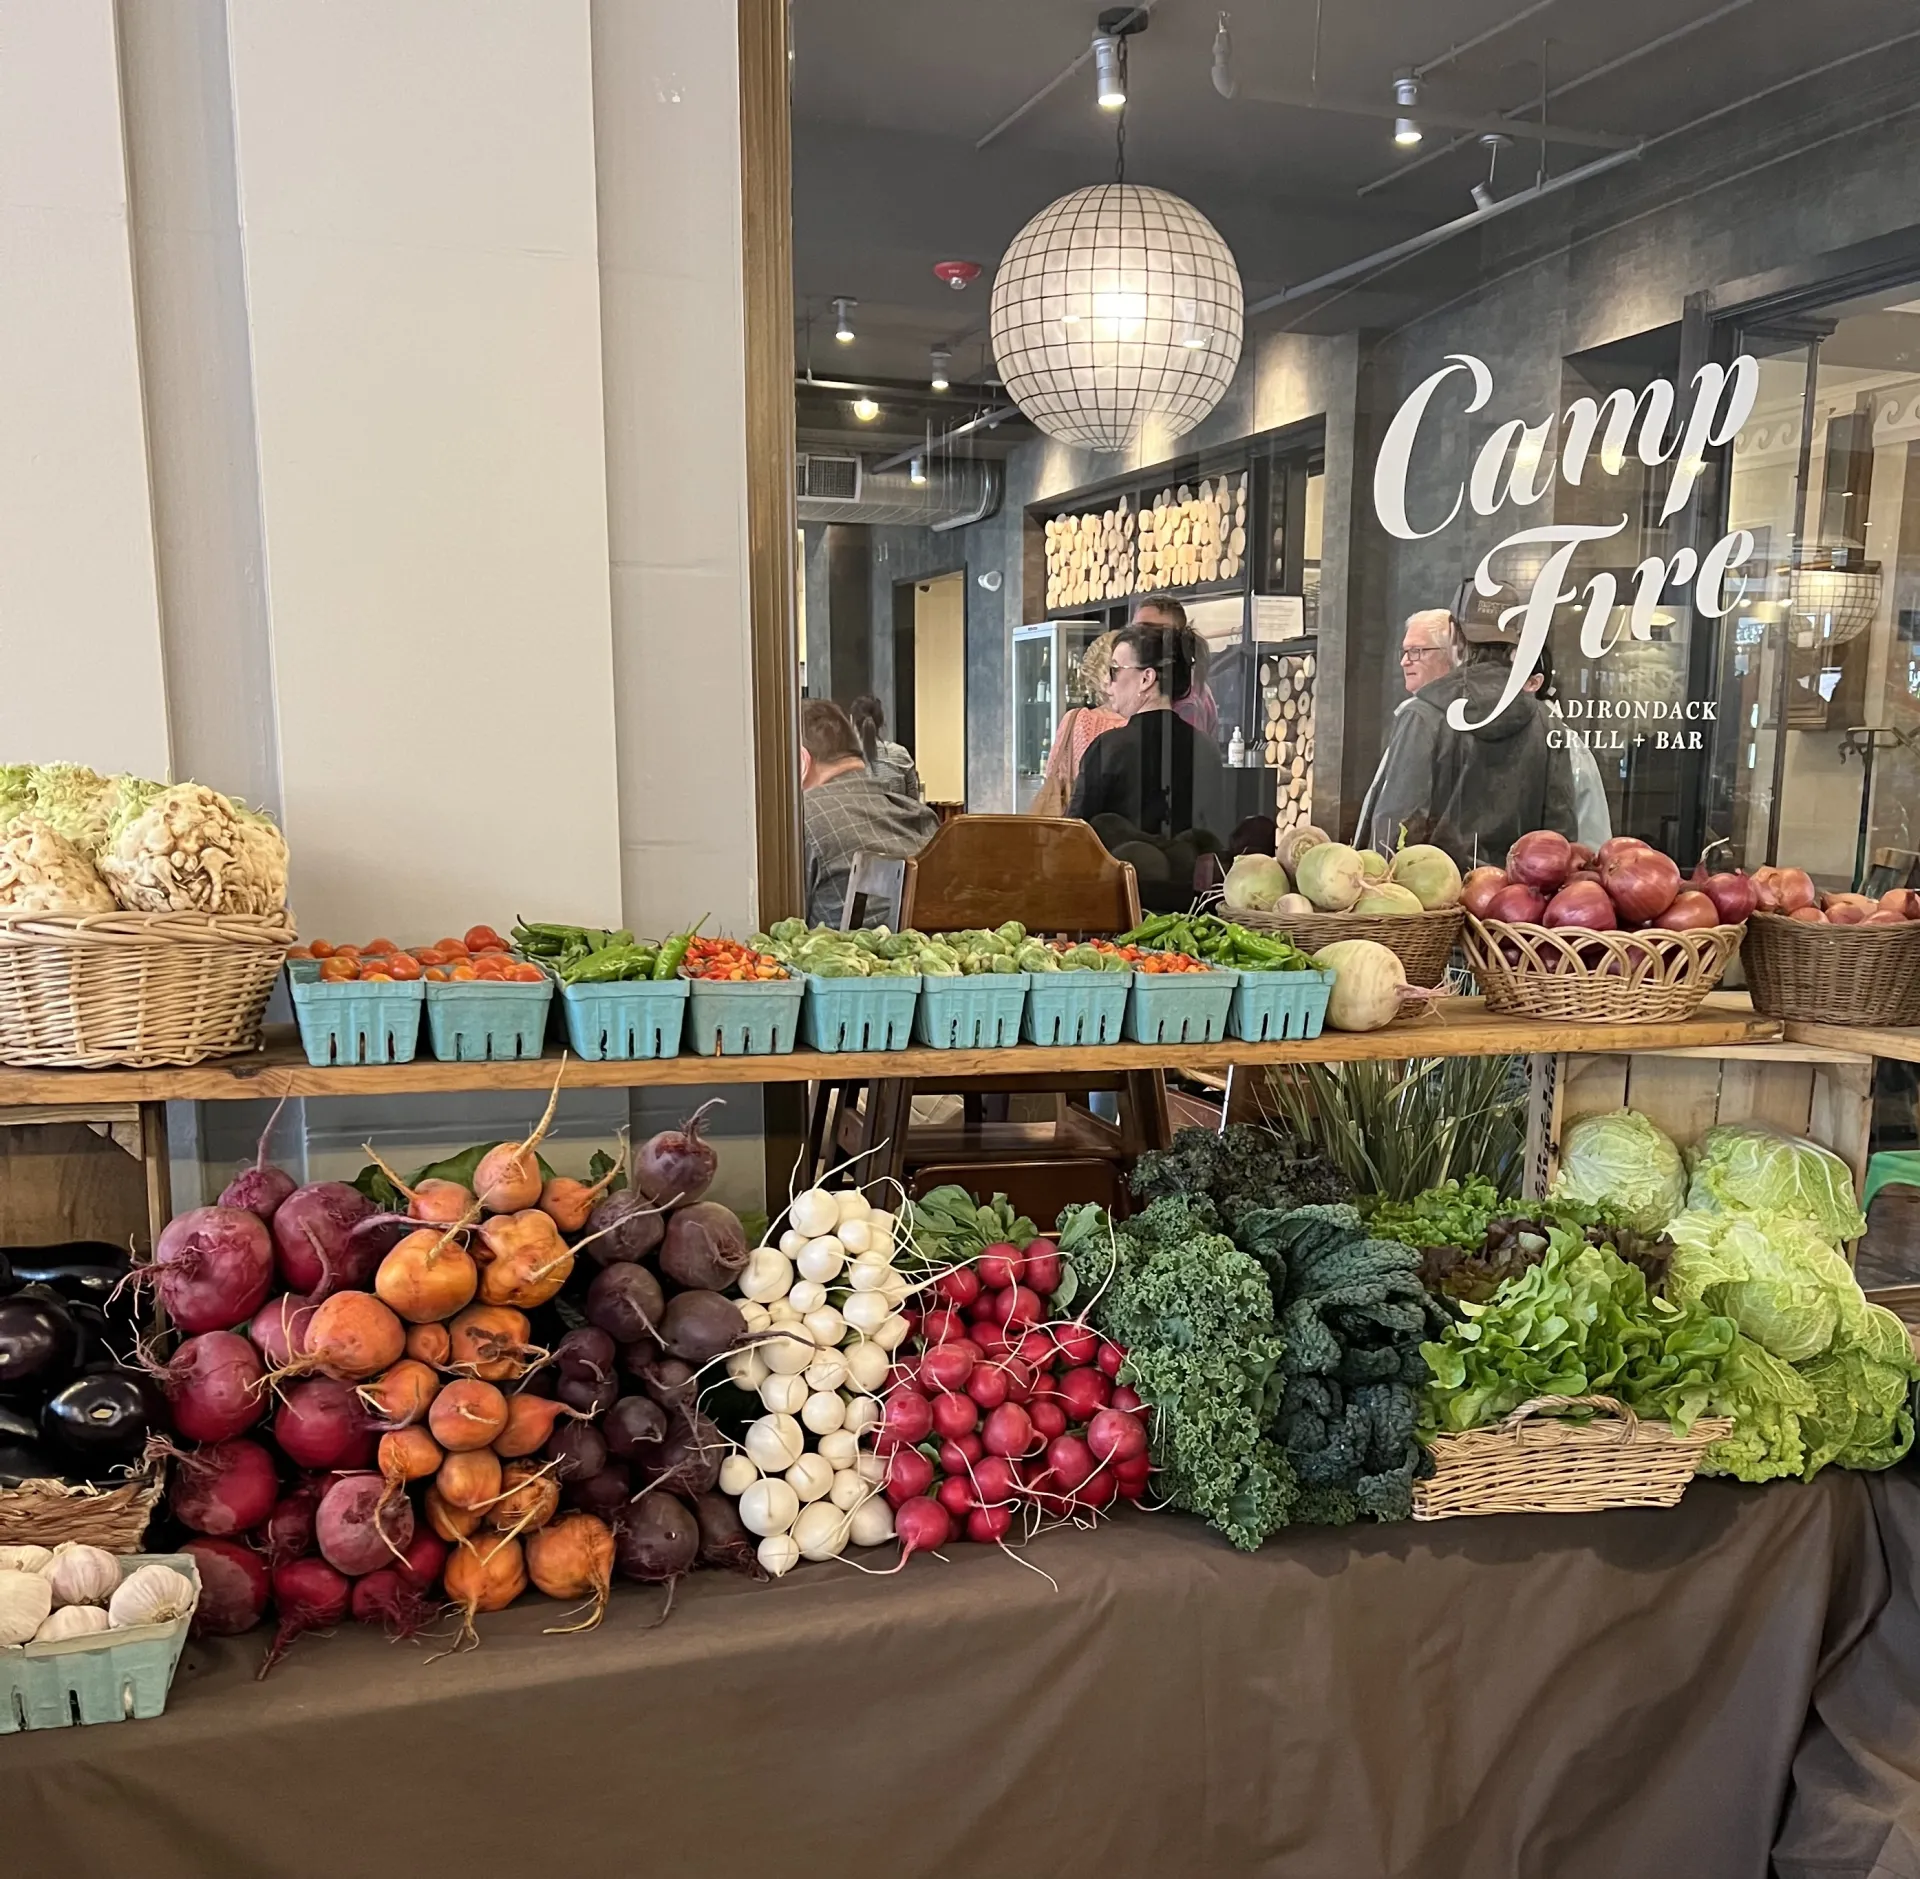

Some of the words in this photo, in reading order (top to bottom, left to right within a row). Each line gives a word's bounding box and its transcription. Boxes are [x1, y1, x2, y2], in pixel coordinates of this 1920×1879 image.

[1374, 354, 1759, 539] Camp
[1446, 513, 1754, 731] Fire
[1546, 730, 1624, 749] GRILL
[1656, 731, 1703, 750] BAR
[1549, 700, 1717, 720] ADIRONDACK
